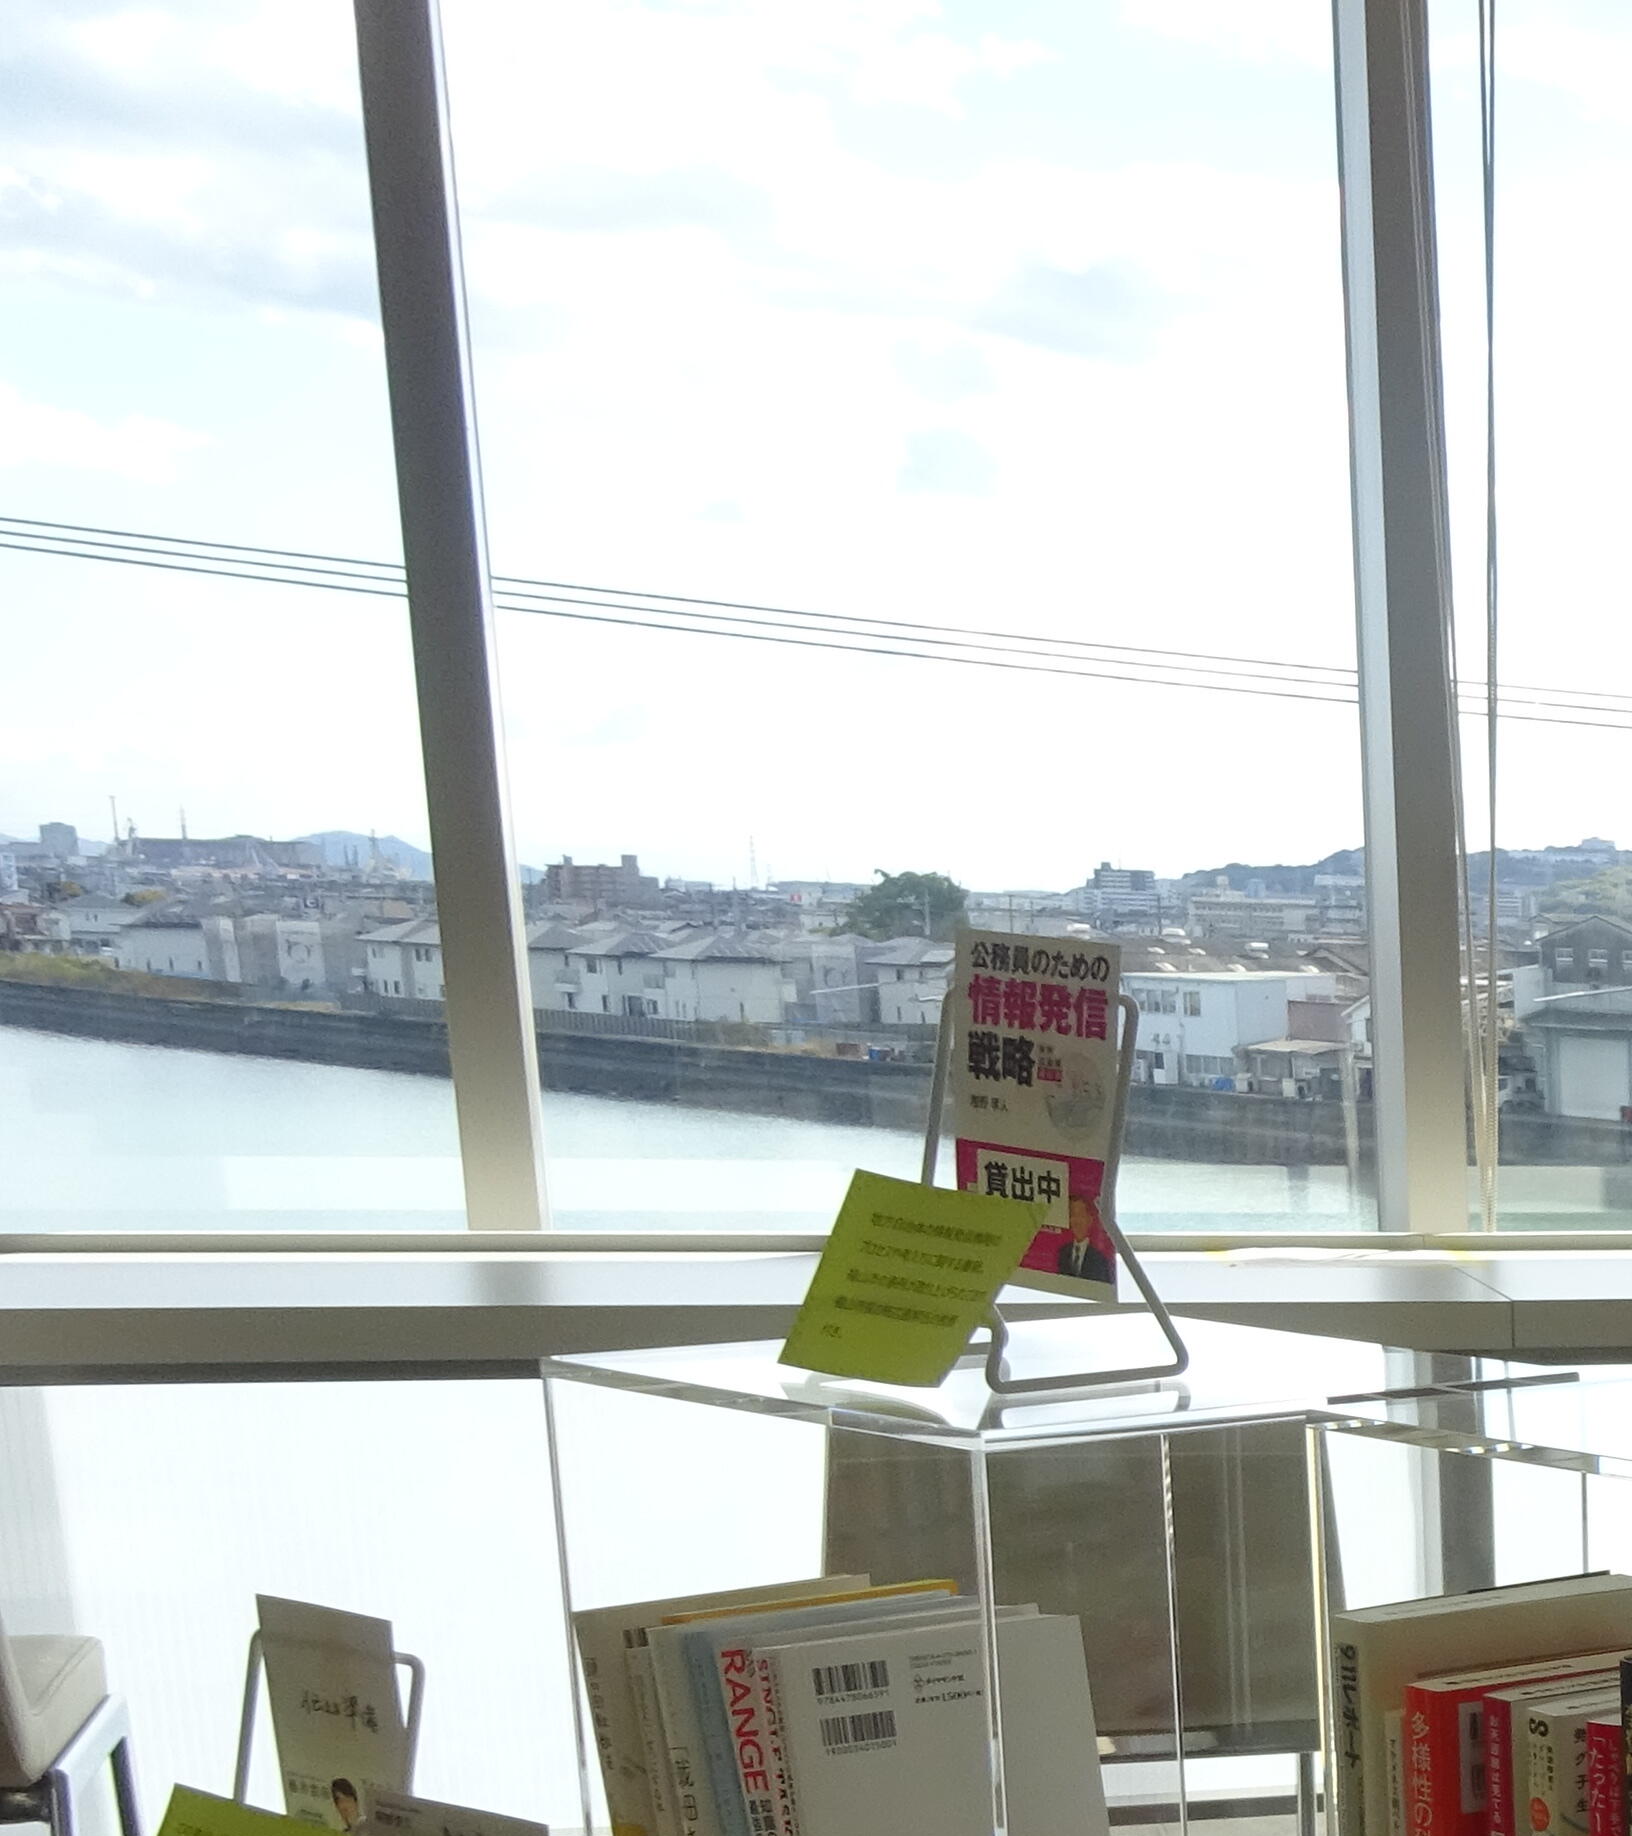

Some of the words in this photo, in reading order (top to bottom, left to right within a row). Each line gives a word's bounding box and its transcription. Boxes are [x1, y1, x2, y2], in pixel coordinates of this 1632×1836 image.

[970, 940, 1111, 982] 公務員のための
[967, 973, 1108, 1042] 情報発信
[967, 1030, 1036, 1087] 戦略
[983, 1160, 1063, 1205] 貸出中
[719, 1648, 769, 1794] RANGE
